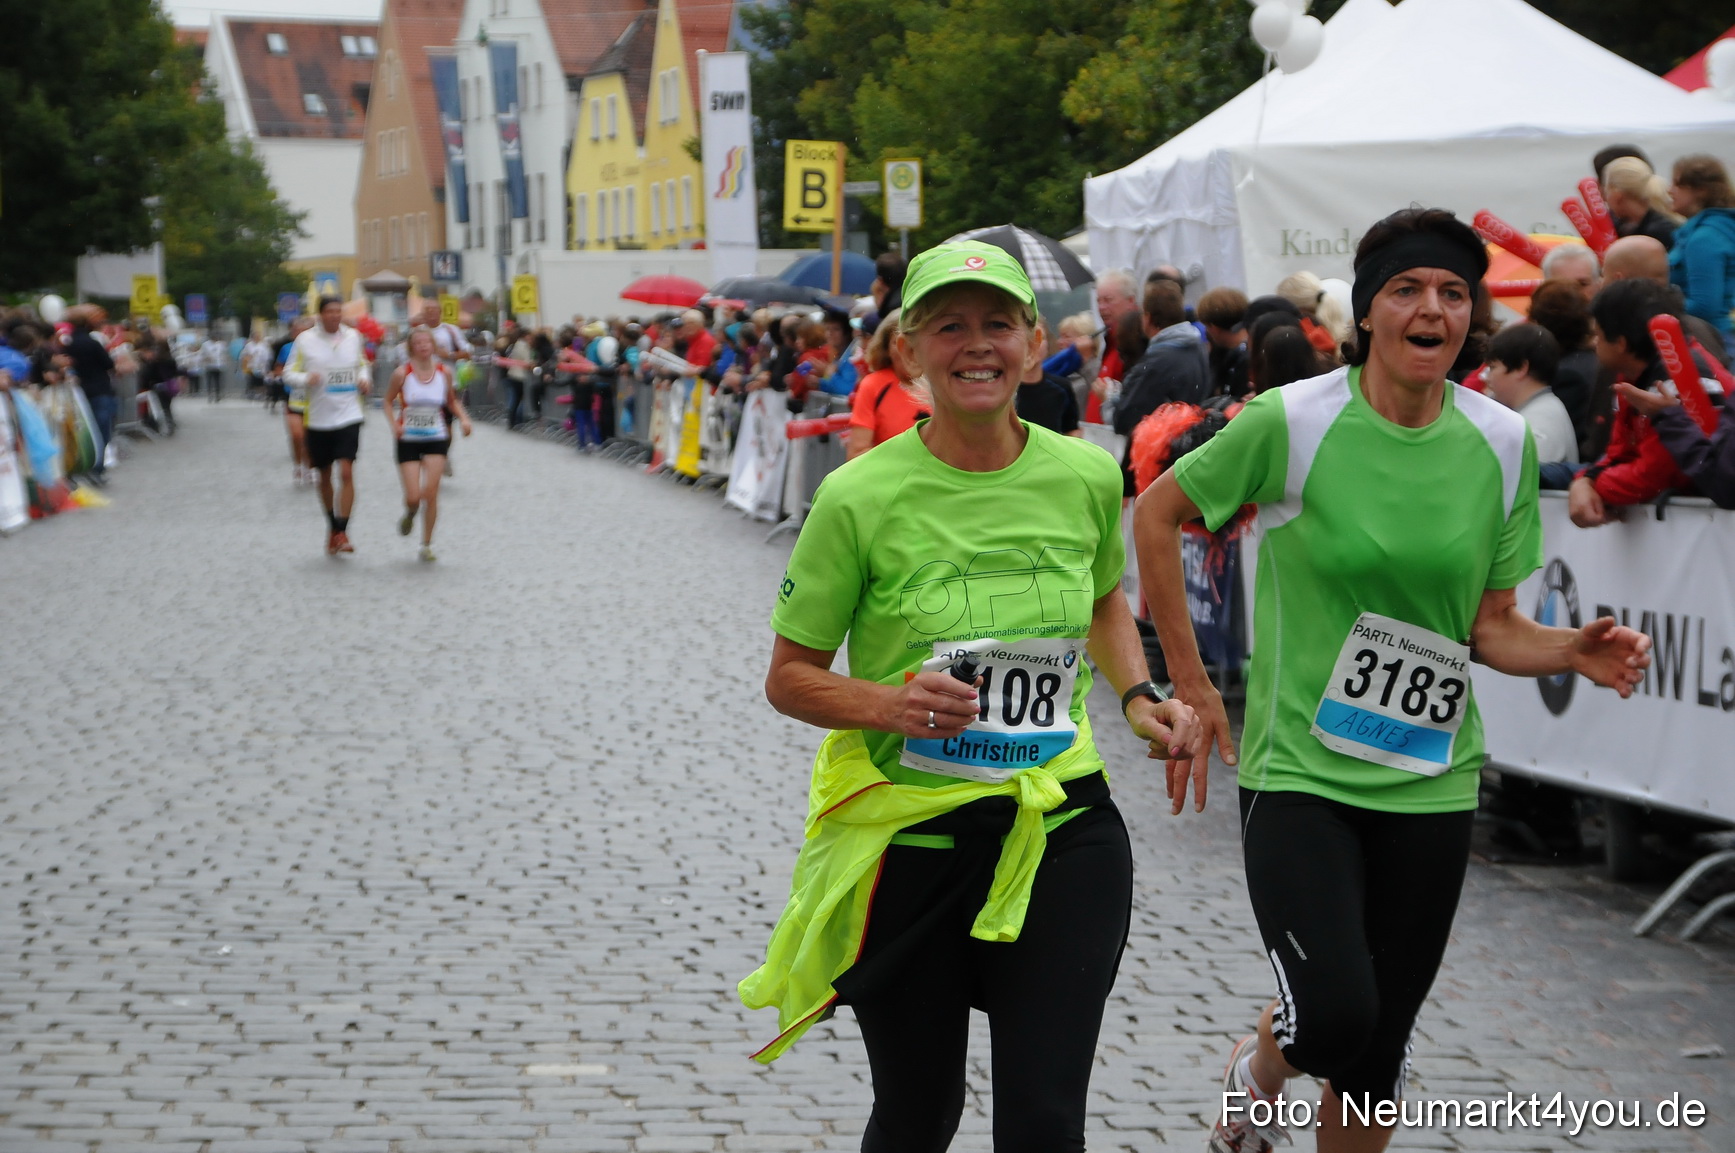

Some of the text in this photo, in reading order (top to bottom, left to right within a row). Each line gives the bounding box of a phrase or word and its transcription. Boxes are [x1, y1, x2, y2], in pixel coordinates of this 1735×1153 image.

[794, 145, 838, 161] Block
[802, 171, 827, 209] B
[953, 631, 971, 641] und
[973, 623, 1081, 640] Automatisierungstechnik
[1352, 624, 1466, 673] PARTL Neumarkt
[986, 649, 1059, 667] Neumarkt
[940, 664, 1062, 728] 108
[1344, 649, 1466, 724] 3183
[1334, 711, 1416, 748] AGNES
[943, 737, 1040, 763] Christine
